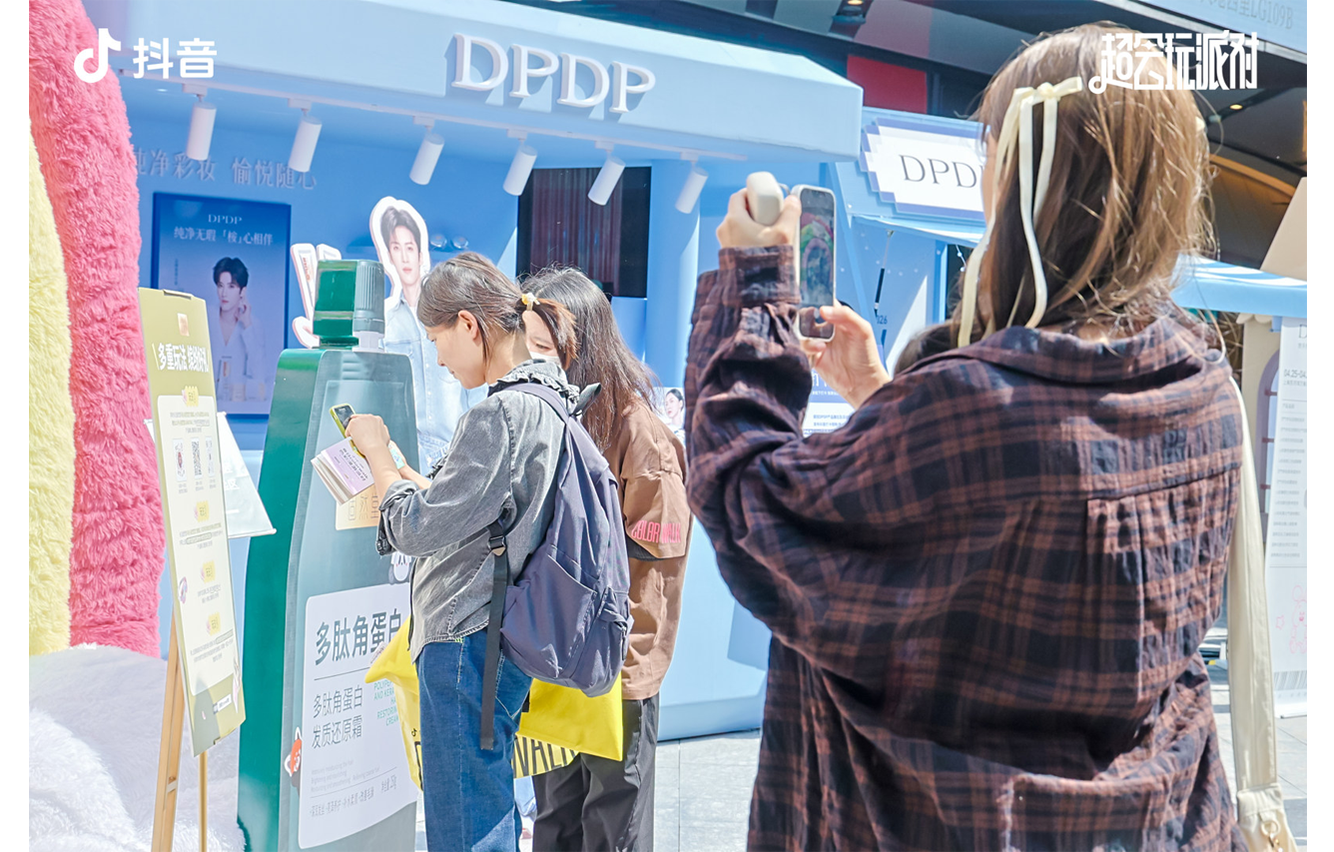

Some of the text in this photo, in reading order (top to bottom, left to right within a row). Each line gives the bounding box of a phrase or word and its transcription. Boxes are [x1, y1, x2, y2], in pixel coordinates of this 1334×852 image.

[450, 33, 656, 114] DPDP
[898, 154, 985, 189] DPD
[207, 213, 243, 225] DPDP
[631, 519, 681, 544] COLOR WALK
[314, 608, 402, 666] 多肽角蛋白
[313, 685, 363, 719] 多肽角蛋白
[311, 715, 362, 749] 发质还原霜
